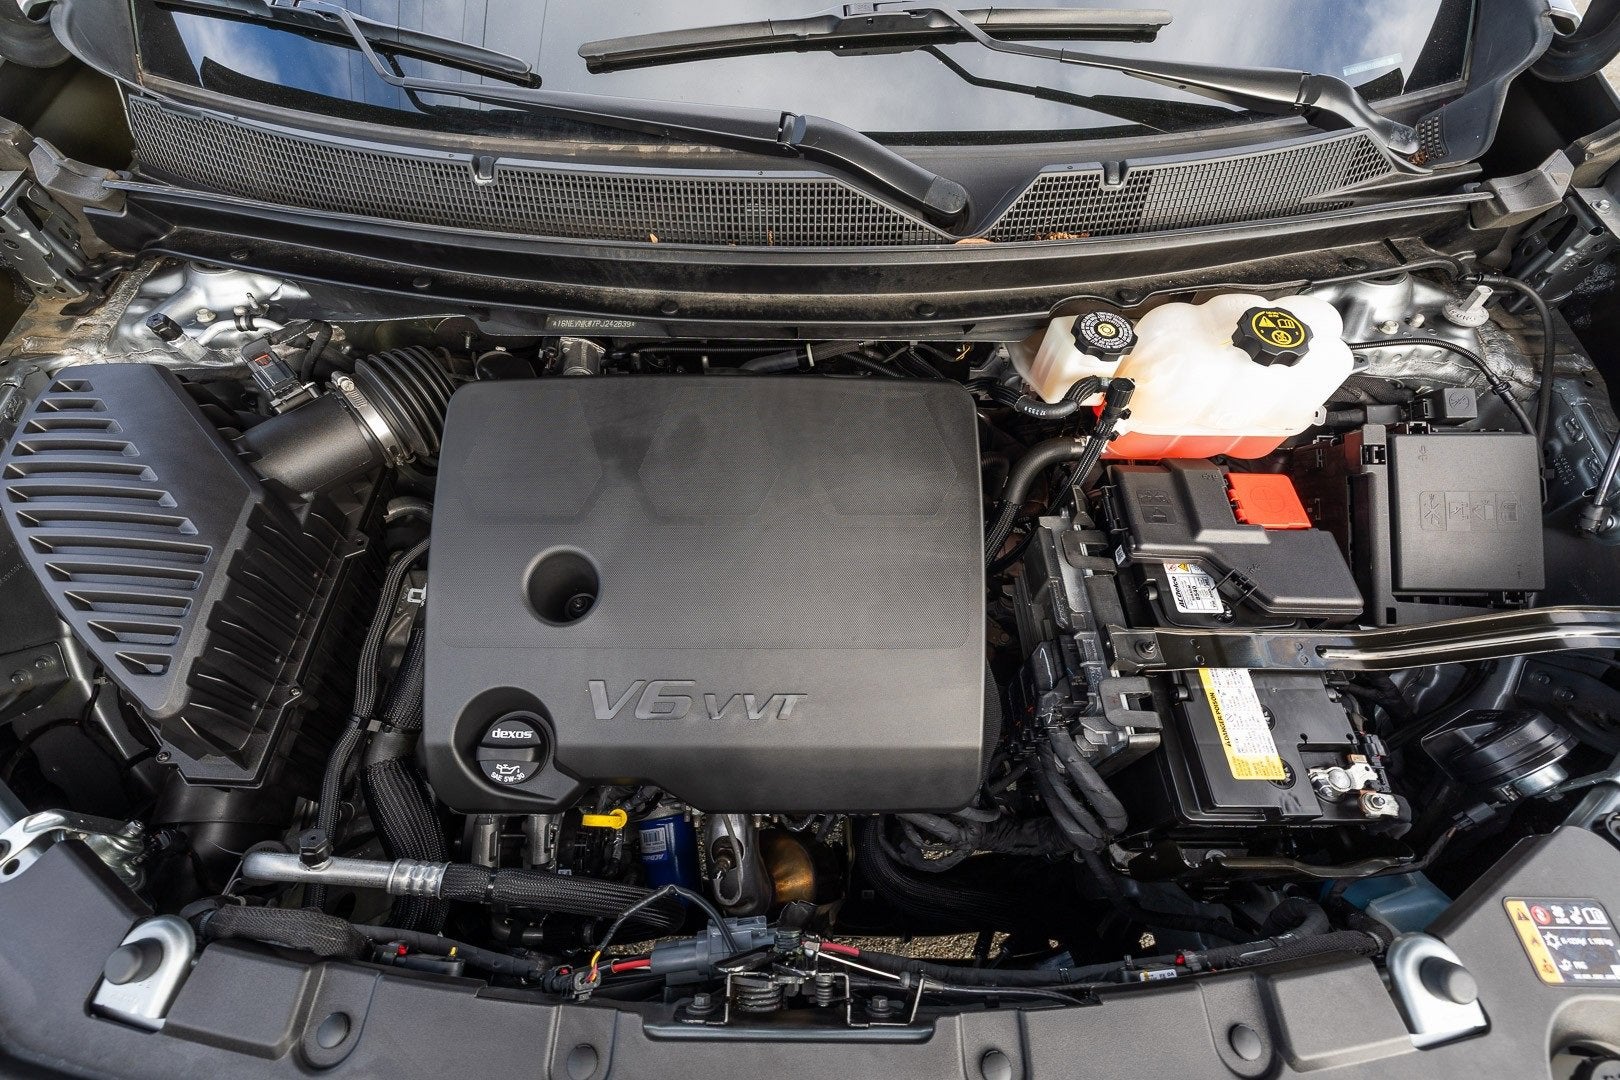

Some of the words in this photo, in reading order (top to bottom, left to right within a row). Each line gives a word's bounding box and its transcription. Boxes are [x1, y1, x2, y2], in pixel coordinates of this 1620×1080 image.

[588, 679, 696, 720] V6
[703, 693, 809, 720] VVT
[1209, 692, 1222, 715] POISON
[491, 727, 534, 739] dexos
[1218, 713, 1231, 742] DANGER
[490, 771, 504, 782] SAE
[503, 772, 526, 783] 5W-30
